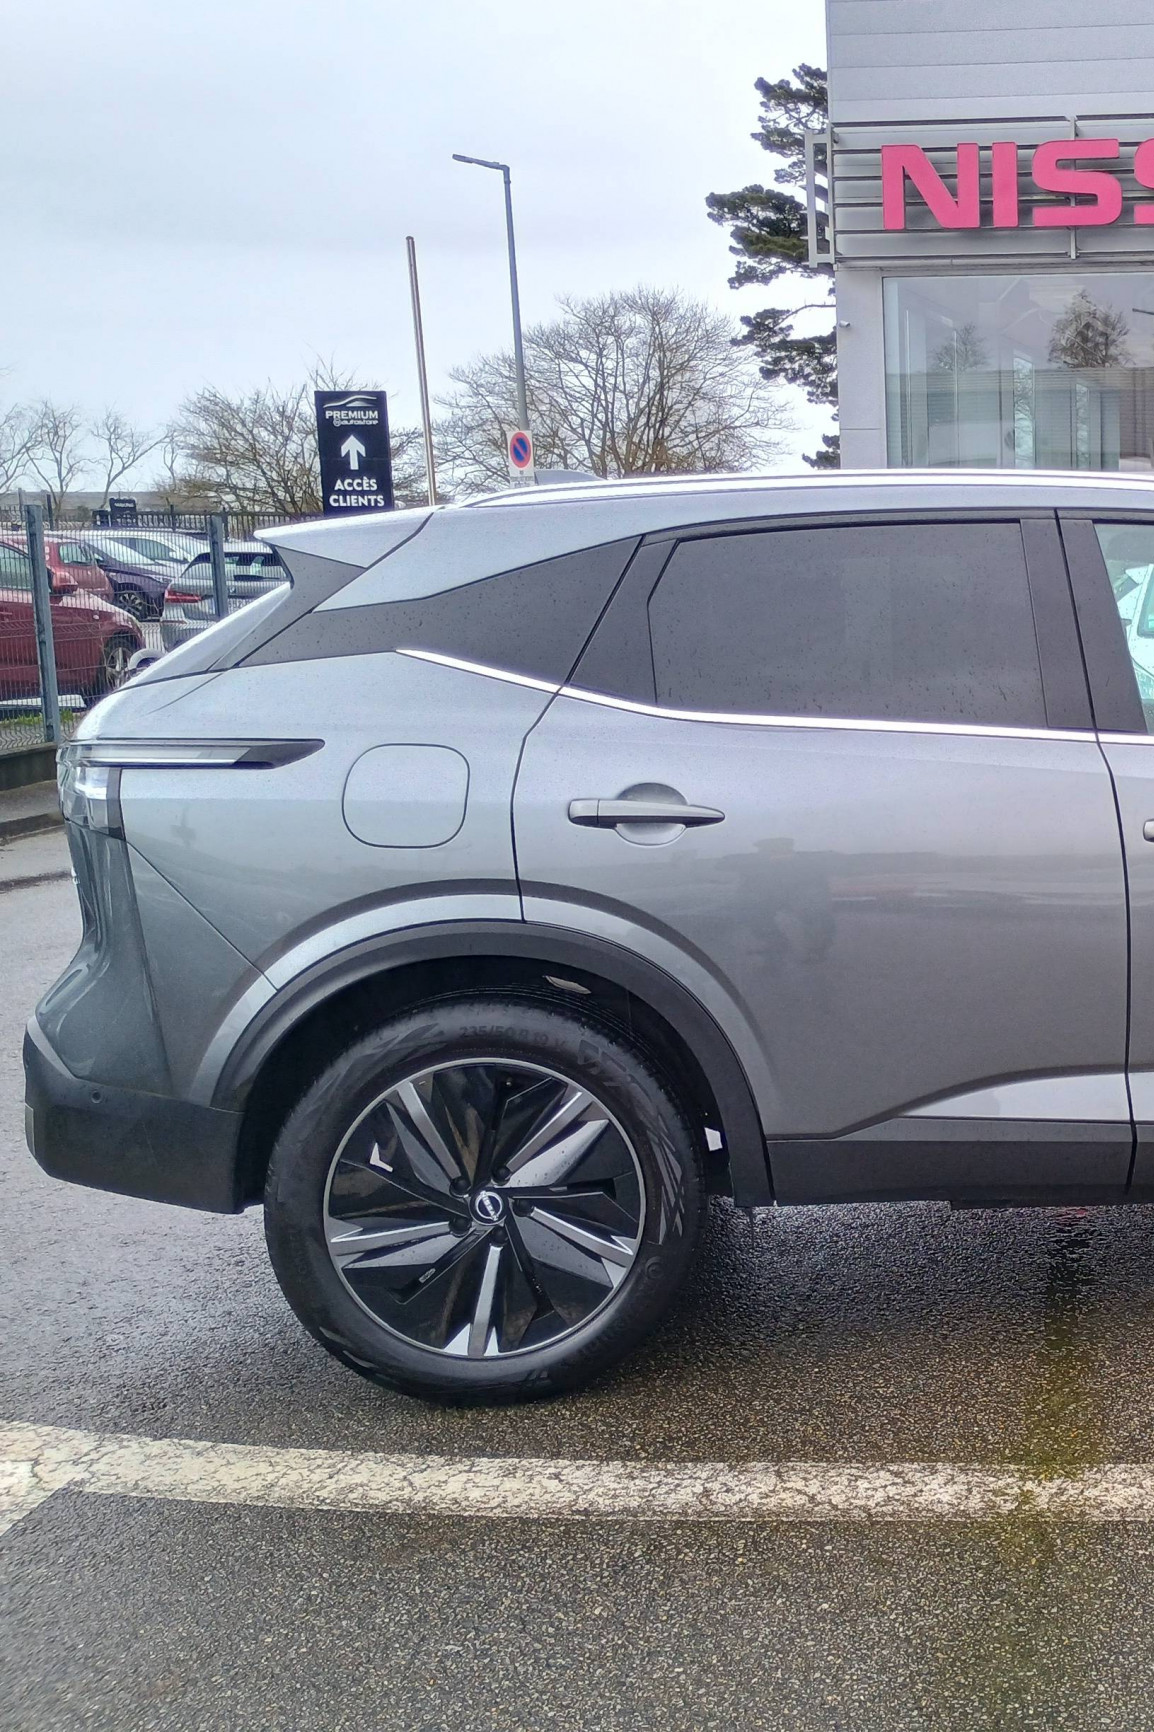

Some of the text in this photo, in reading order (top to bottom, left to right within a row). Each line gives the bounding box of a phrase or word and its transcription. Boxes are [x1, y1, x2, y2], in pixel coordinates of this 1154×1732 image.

[325, 410, 379, 419] PREMIUM
[334, 476, 378, 491] ACCÈS
[329, 494, 385, 507] CLIENTS
